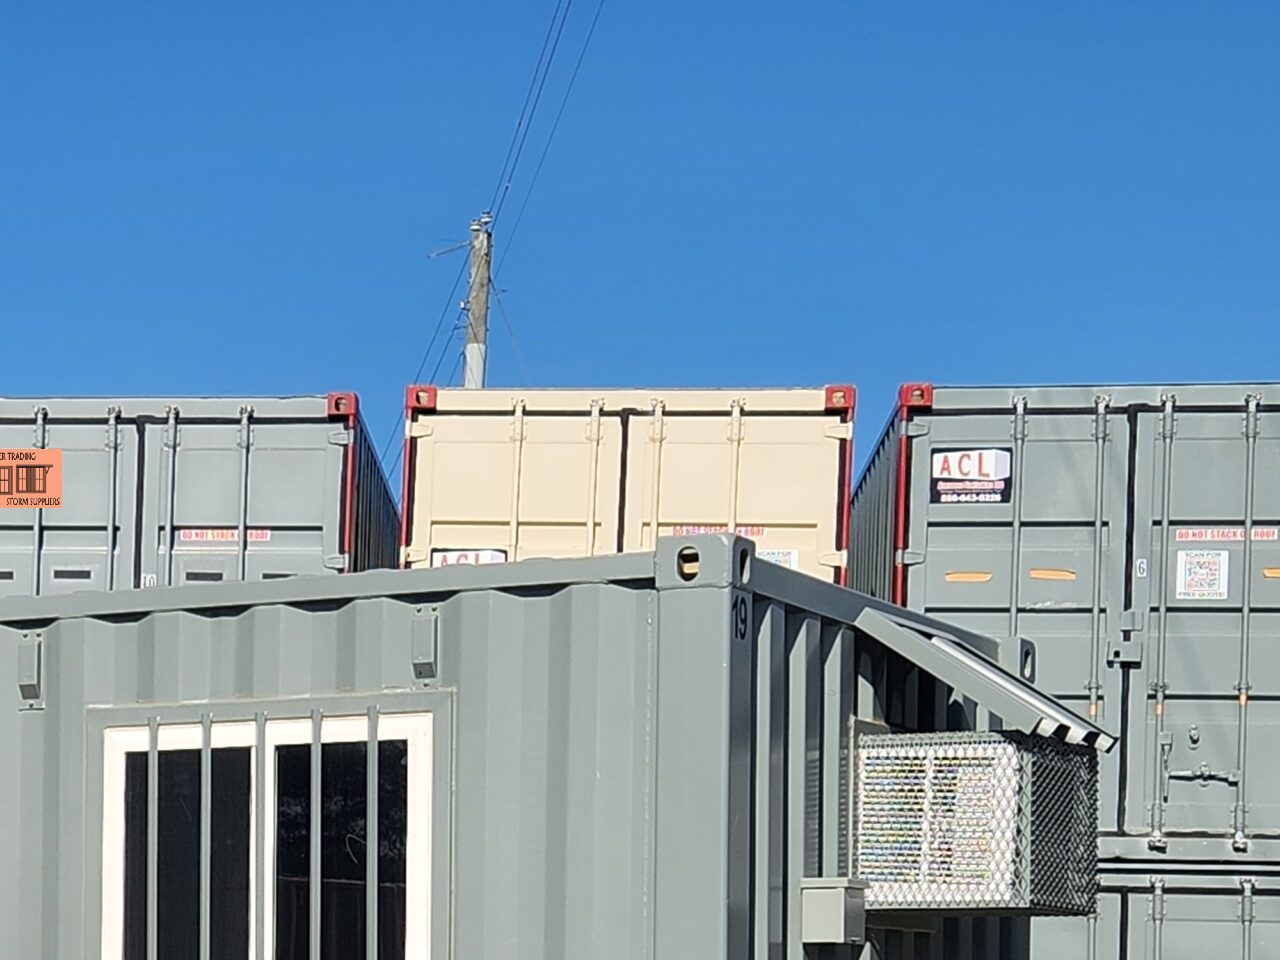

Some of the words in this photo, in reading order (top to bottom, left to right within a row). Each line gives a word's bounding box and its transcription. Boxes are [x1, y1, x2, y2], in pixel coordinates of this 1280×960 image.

[939, 452, 990, 477] ACL
[1177, 529, 1190, 539] DO
[1191, 529, 1208, 539] NOT
[1210, 529, 1238, 539] STACK
[1138, 561, 1145, 575] 6
[732, 594, 748, 641] 19
